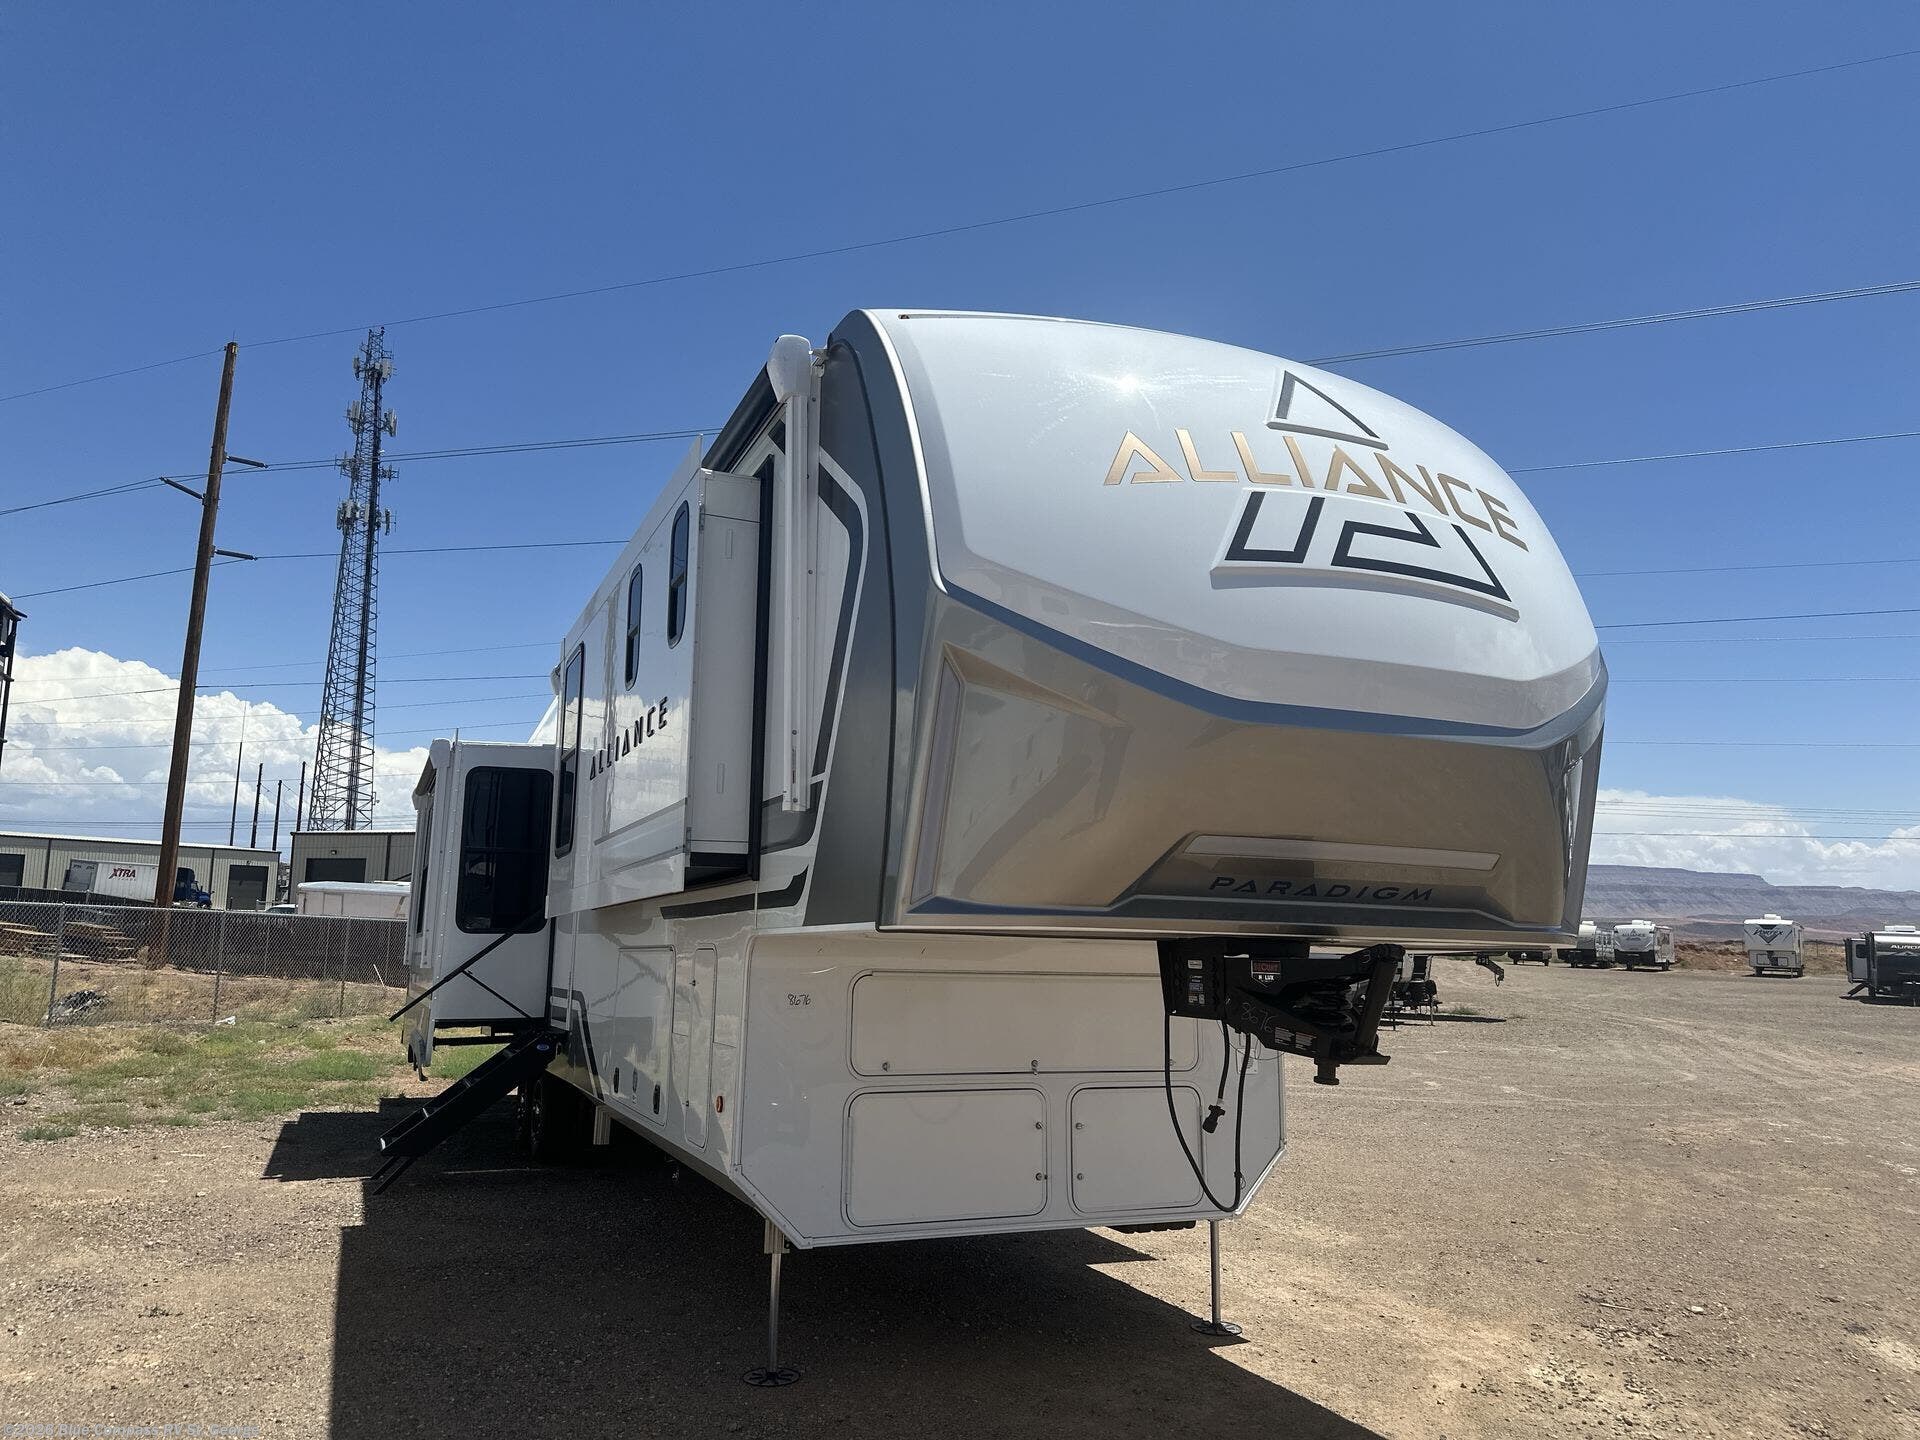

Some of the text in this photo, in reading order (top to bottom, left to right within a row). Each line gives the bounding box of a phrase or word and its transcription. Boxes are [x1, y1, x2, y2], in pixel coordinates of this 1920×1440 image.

[1105, 428, 1529, 551] ALLIANCE
[590, 696, 668, 780] ALLIANCE
[109, 868, 136, 879] XTRA
[1209, 876, 1433, 902] PARADIGM
[788, 994, 811, 1005] 8676
